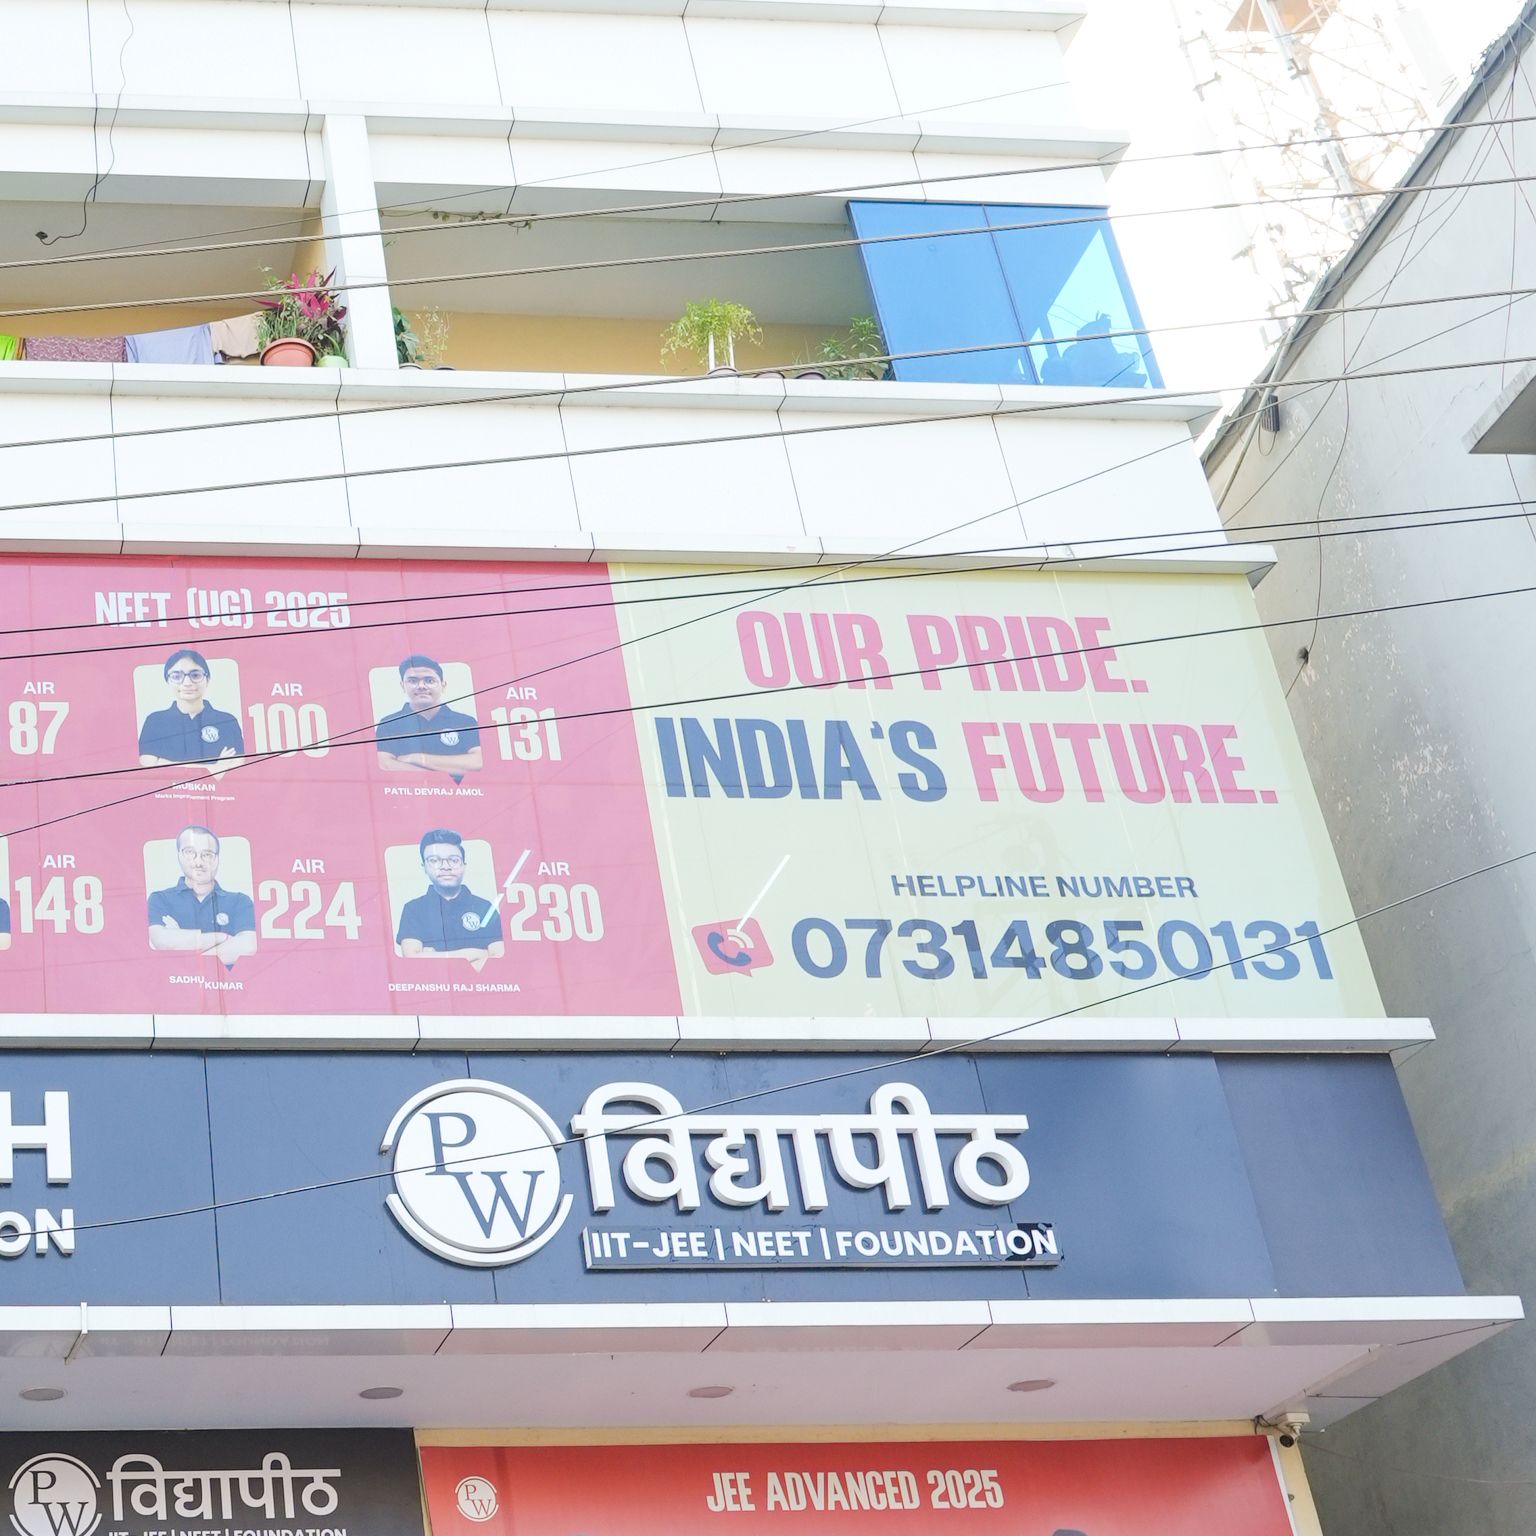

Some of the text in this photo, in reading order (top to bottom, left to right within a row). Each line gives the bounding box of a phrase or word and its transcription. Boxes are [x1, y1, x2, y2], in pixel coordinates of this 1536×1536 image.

[94, 587, 351, 629] NEET (UG) 2025
[735, 610, 1150, 694] OUR PRIDE.
[23, 681, 56, 695] AIR
[271, 683, 303, 697] AIR
[505, 687, 537, 700] AIR
[8, 700, 70, 755] 87
[248, 702, 330, 758] 100
[491, 706, 562, 762] 131
[654, 717, 1279, 805] INDIA'S FUTURE.
[384, 787, 484, 796] PATIL DEVRAJ AMOL
[42, 855, 76, 869] AIR
[291, 859, 325, 874] AIR
[537, 862, 570, 876] AIR
[14, 875, 105, 934] 148
[891, 874, 1198, 899] HELPLINE NUMBER
[258, 880, 363, 940] 224
[506, 883, 604, 942] 230
[791, 917, 1335, 982] 07314850131
[169, 975, 243, 990] SADHU KUMAR
[388, 983, 521, 993] DEEPANSHU RAJ SHARMA
[571, 1082, 1031, 1213] विद्यापीठ
[592, 1229, 1059, 1258] IIT-JEE NEET FOUNDATION
[107, 1452, 342, 1521] विद्यापीठ
[706, 1469, 1004, 1512] JEE ADVANCED 2025
